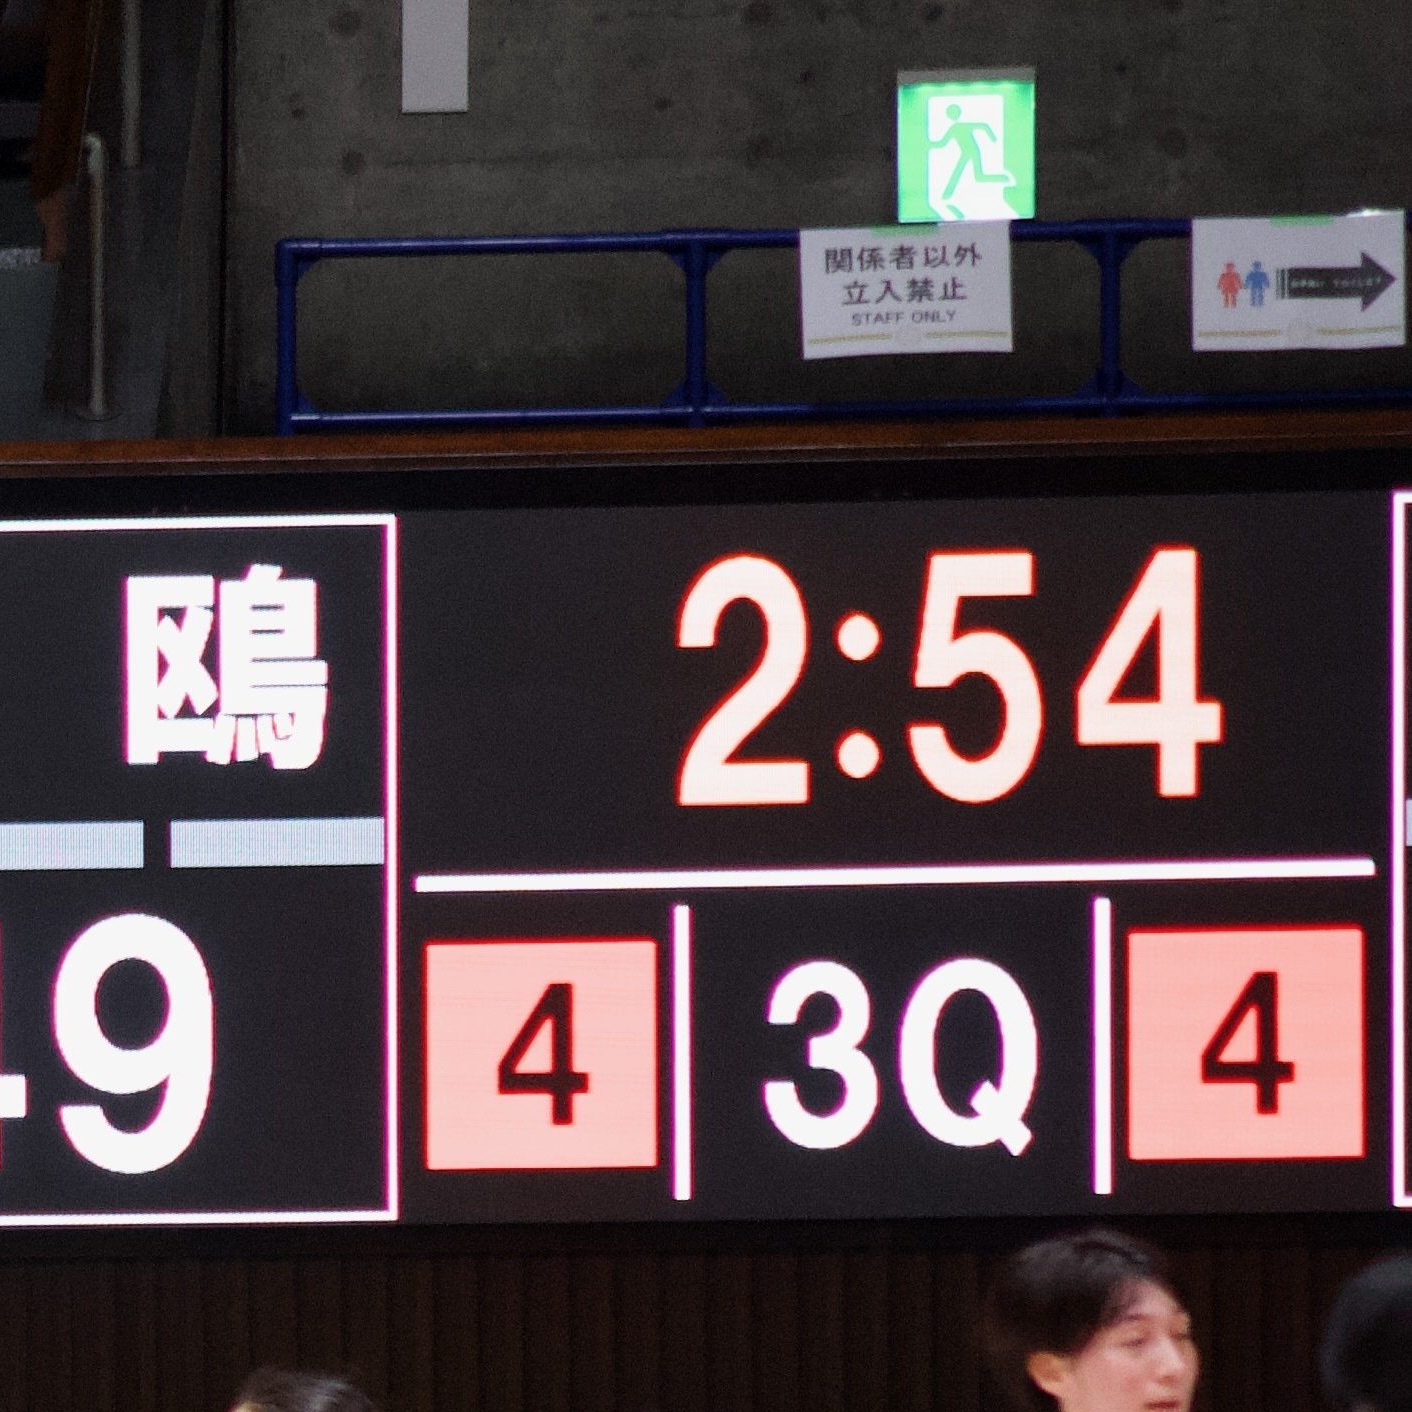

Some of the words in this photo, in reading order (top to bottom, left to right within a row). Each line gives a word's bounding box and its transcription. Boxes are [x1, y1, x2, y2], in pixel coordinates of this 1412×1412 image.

[824, 241, 983, 275] 関係者以外
[841, 276, 968, 306] 立入禁止
[851, 311, 905, 326] STAFF
[911, 309, 957, 324] ONLY
[679, 548, 1223, 808] 2:54
[497, 982, 591, 1128] 4
[764, 958, 1040, 1159] 3Q
[1201, 971, 1297, 1117] 4
